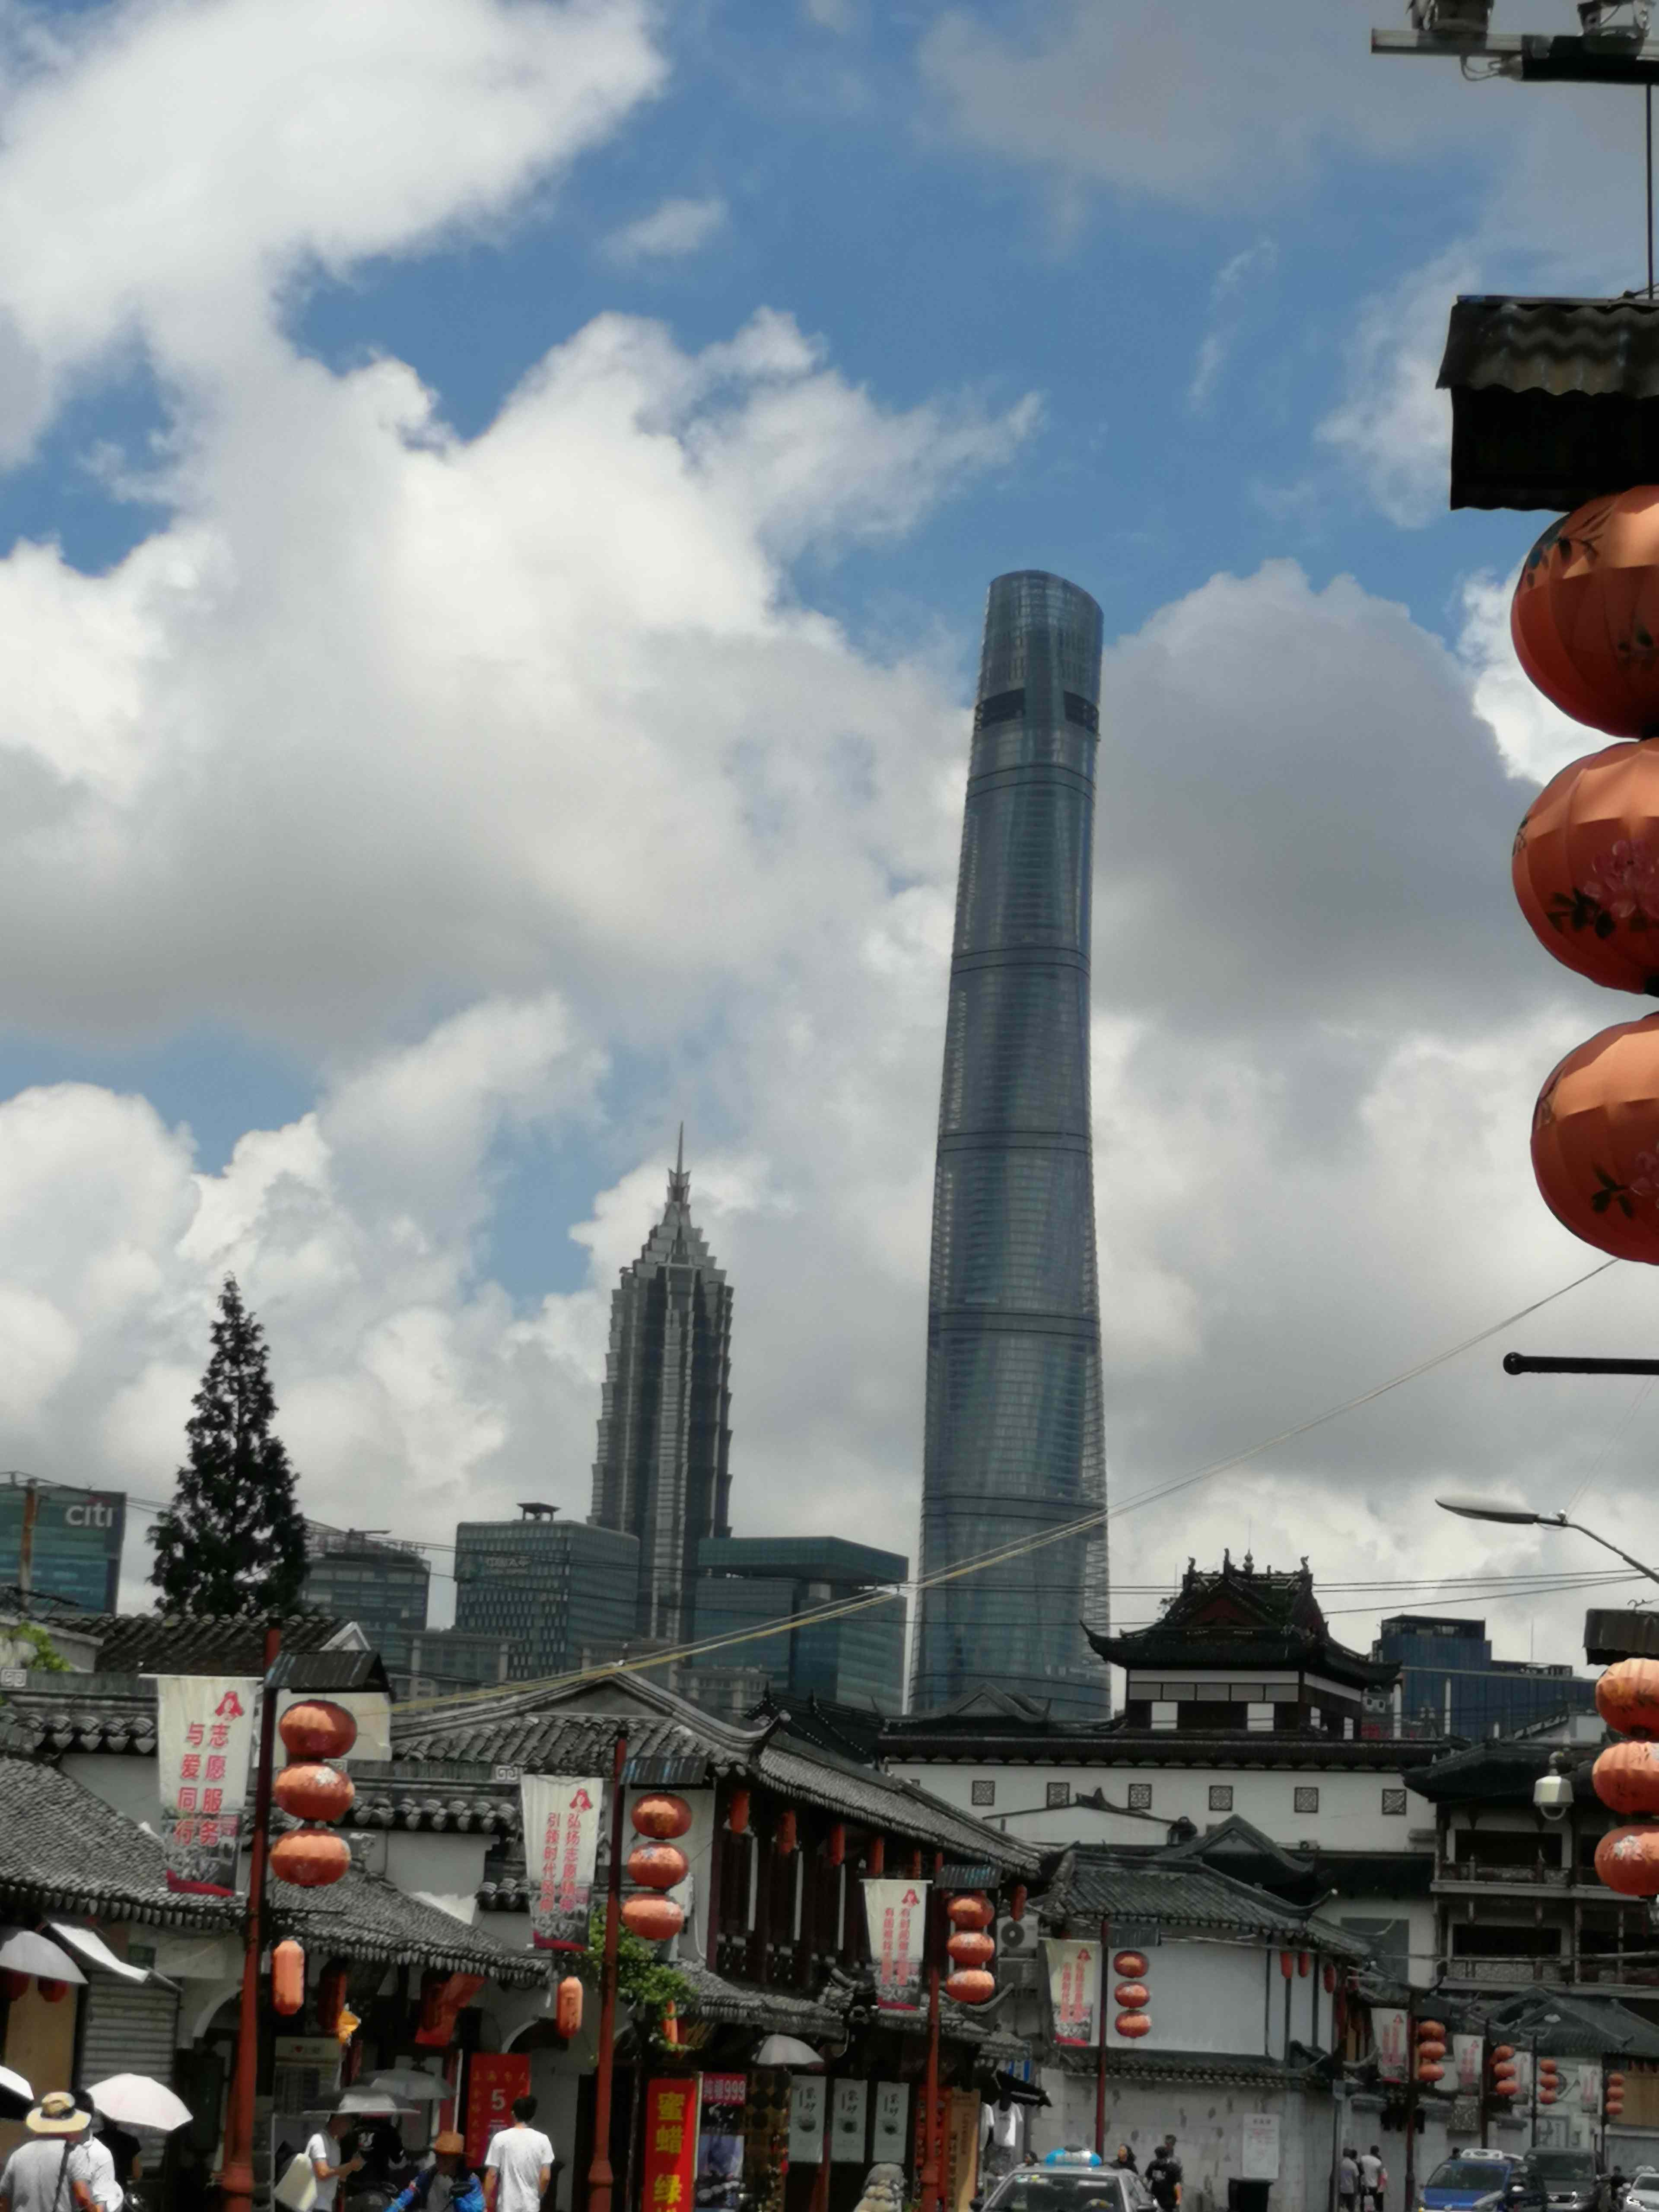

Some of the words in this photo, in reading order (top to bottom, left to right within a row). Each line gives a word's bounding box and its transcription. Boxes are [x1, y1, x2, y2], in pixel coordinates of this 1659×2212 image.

[66, 1502, 114, 1527] citi
[173, 1722, 205, 1846] 与爱同行
[199, 1723, 230, 1846] 志愿服务
[491, 2088, 506, 2111] 5
[655, 2092, 686, 2154] 蜜蜡
